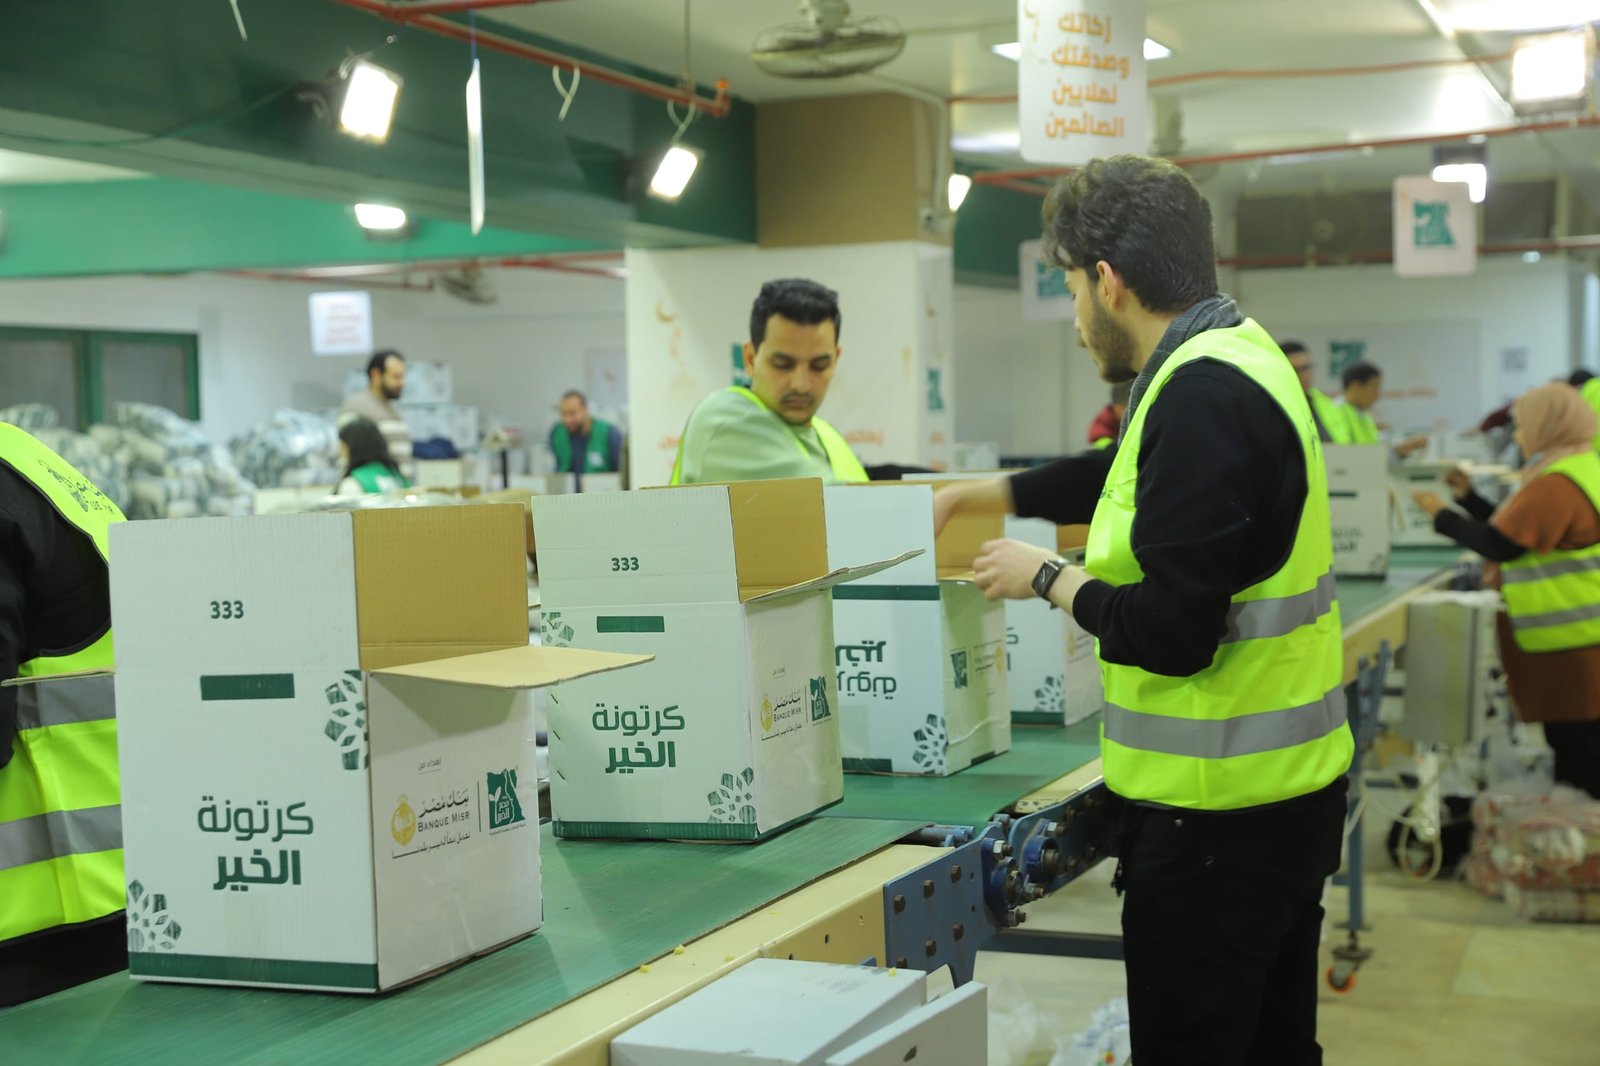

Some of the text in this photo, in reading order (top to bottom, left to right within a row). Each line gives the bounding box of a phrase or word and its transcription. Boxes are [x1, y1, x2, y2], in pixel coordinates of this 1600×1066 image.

[1058, 12, 1112, 44] زكاتك
[1051, 78, 1118, 107] لملايين
[1044, 110, 1125, 139] الصائمين
[610, 556, 640, 572] 333
[210, 600, 245, 620] 333
[834, 641, 887, 668] لخير
[836, 671, 897, 700] رتونة
[592, 702, 685, 737] كرتونة
[605, 740, 676, 774] الخير
[197, 795, 315, 842] كرتونة
[417, 816, 449, 833] BANQUE
[213, 848, 302, 892] الخير
